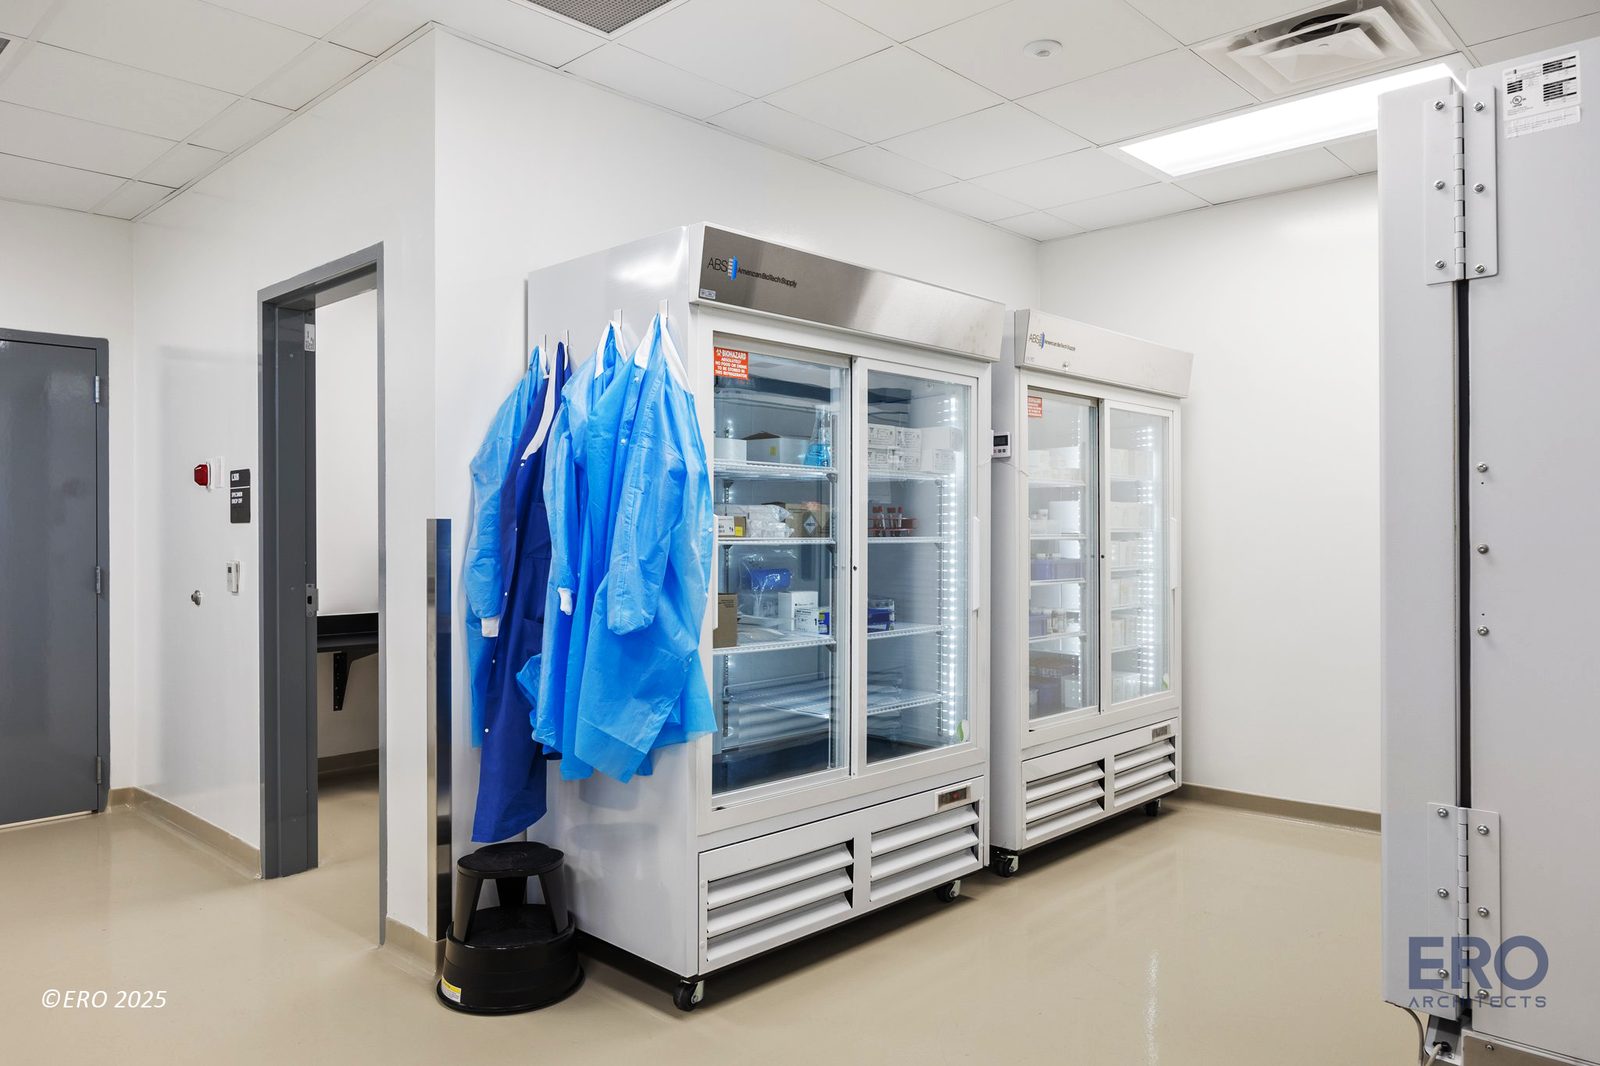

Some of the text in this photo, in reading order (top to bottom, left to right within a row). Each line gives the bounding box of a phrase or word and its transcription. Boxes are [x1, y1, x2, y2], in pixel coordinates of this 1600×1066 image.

[707, 257, 728, 273] ABS
[1029, 333, 1040, 345] ABS
[722, 350, 746, 360] BIOHAZARD
